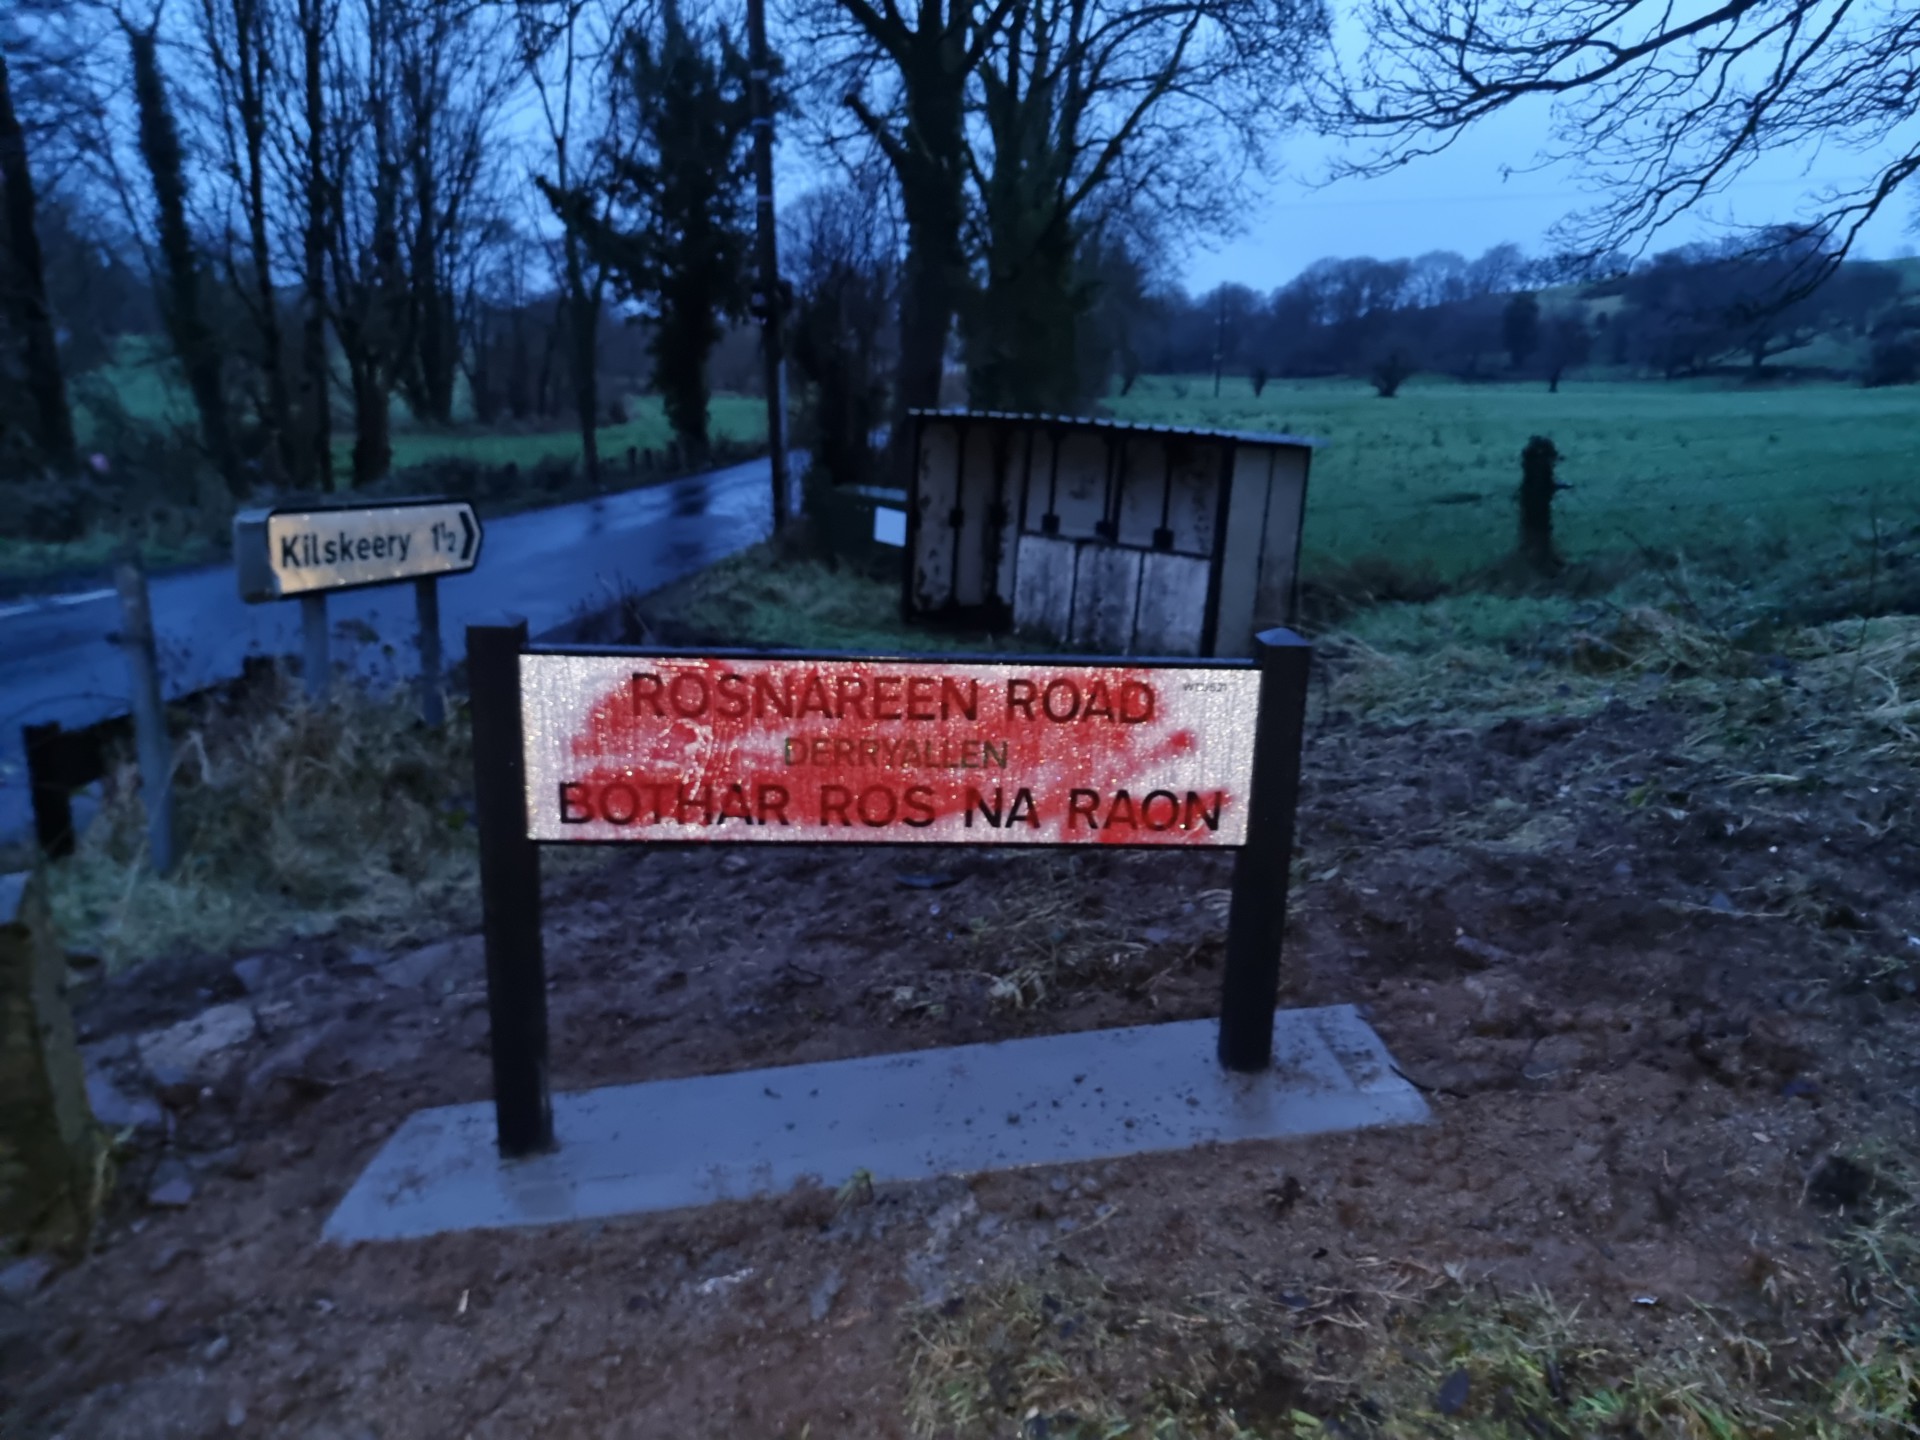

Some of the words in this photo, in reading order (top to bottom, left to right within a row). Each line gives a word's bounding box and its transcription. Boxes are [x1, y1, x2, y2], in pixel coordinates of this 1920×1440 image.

[281, 532, 411, 568] Kilskeery
[632, 672, 978, 722] ROSNAREEN
[1006, 677, 1156, 723] ROAD
[785, 737, 1008, 769] DERRYALLEN
[559, 782, 790, 826] BOTHAR
[820, 784, 936, 828] ROS
[964, 787, 1041, 829] NA
[1067, 788, 1224, 832] RAON
